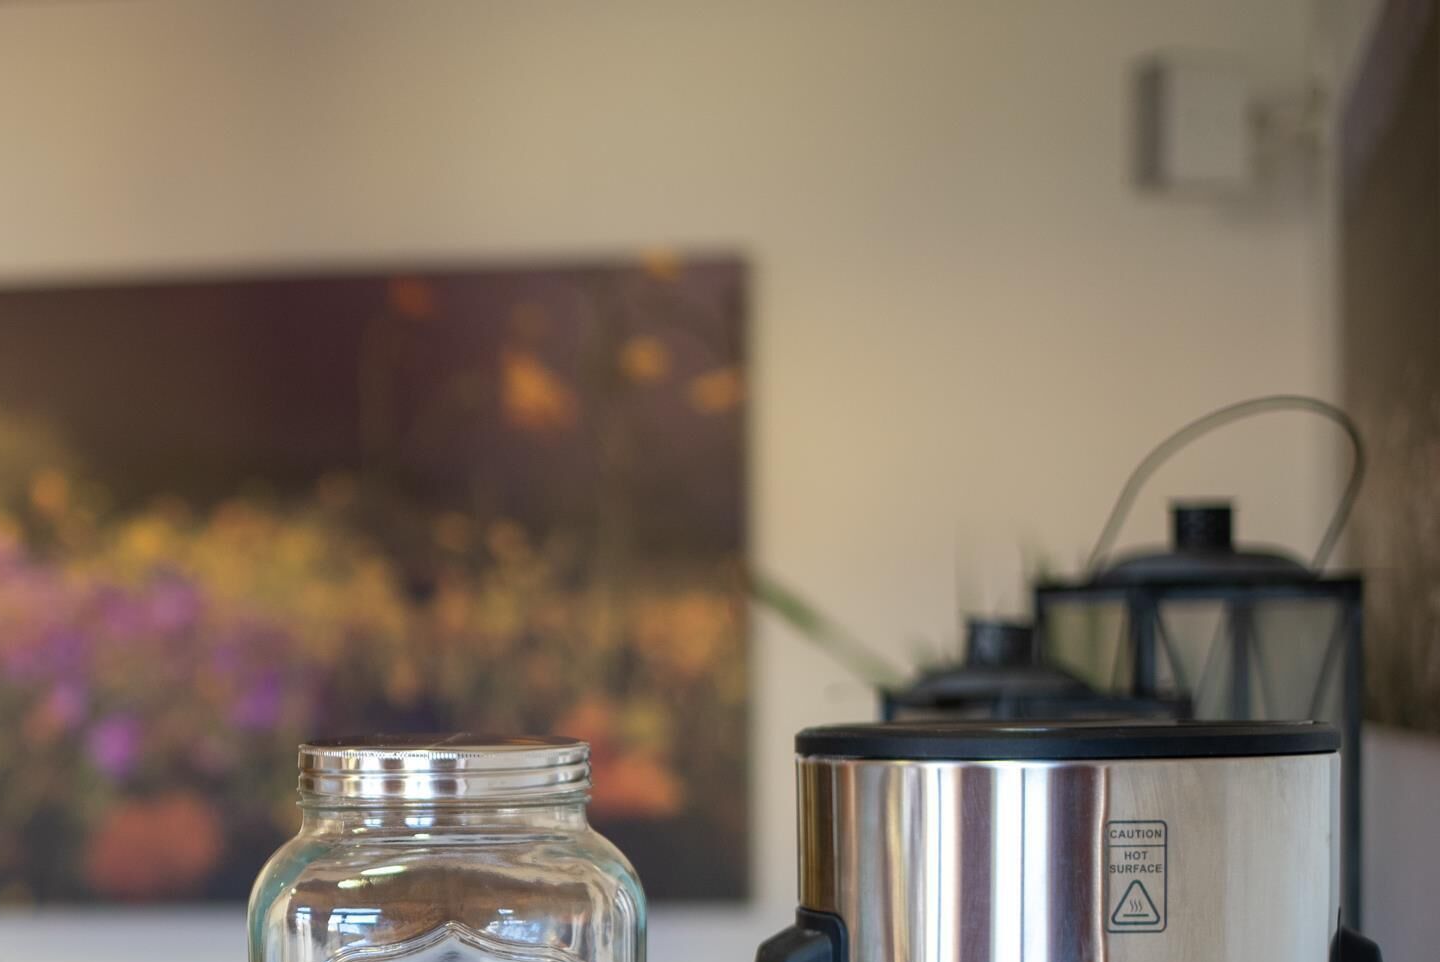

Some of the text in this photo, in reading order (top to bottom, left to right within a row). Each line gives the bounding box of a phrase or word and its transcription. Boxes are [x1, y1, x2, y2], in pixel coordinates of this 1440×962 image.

[1110, 829, 1162, 839] CAUTION
[1123, 851, 1148, 860] HOT
[1109, 864, 1162, 874] SURFACE
